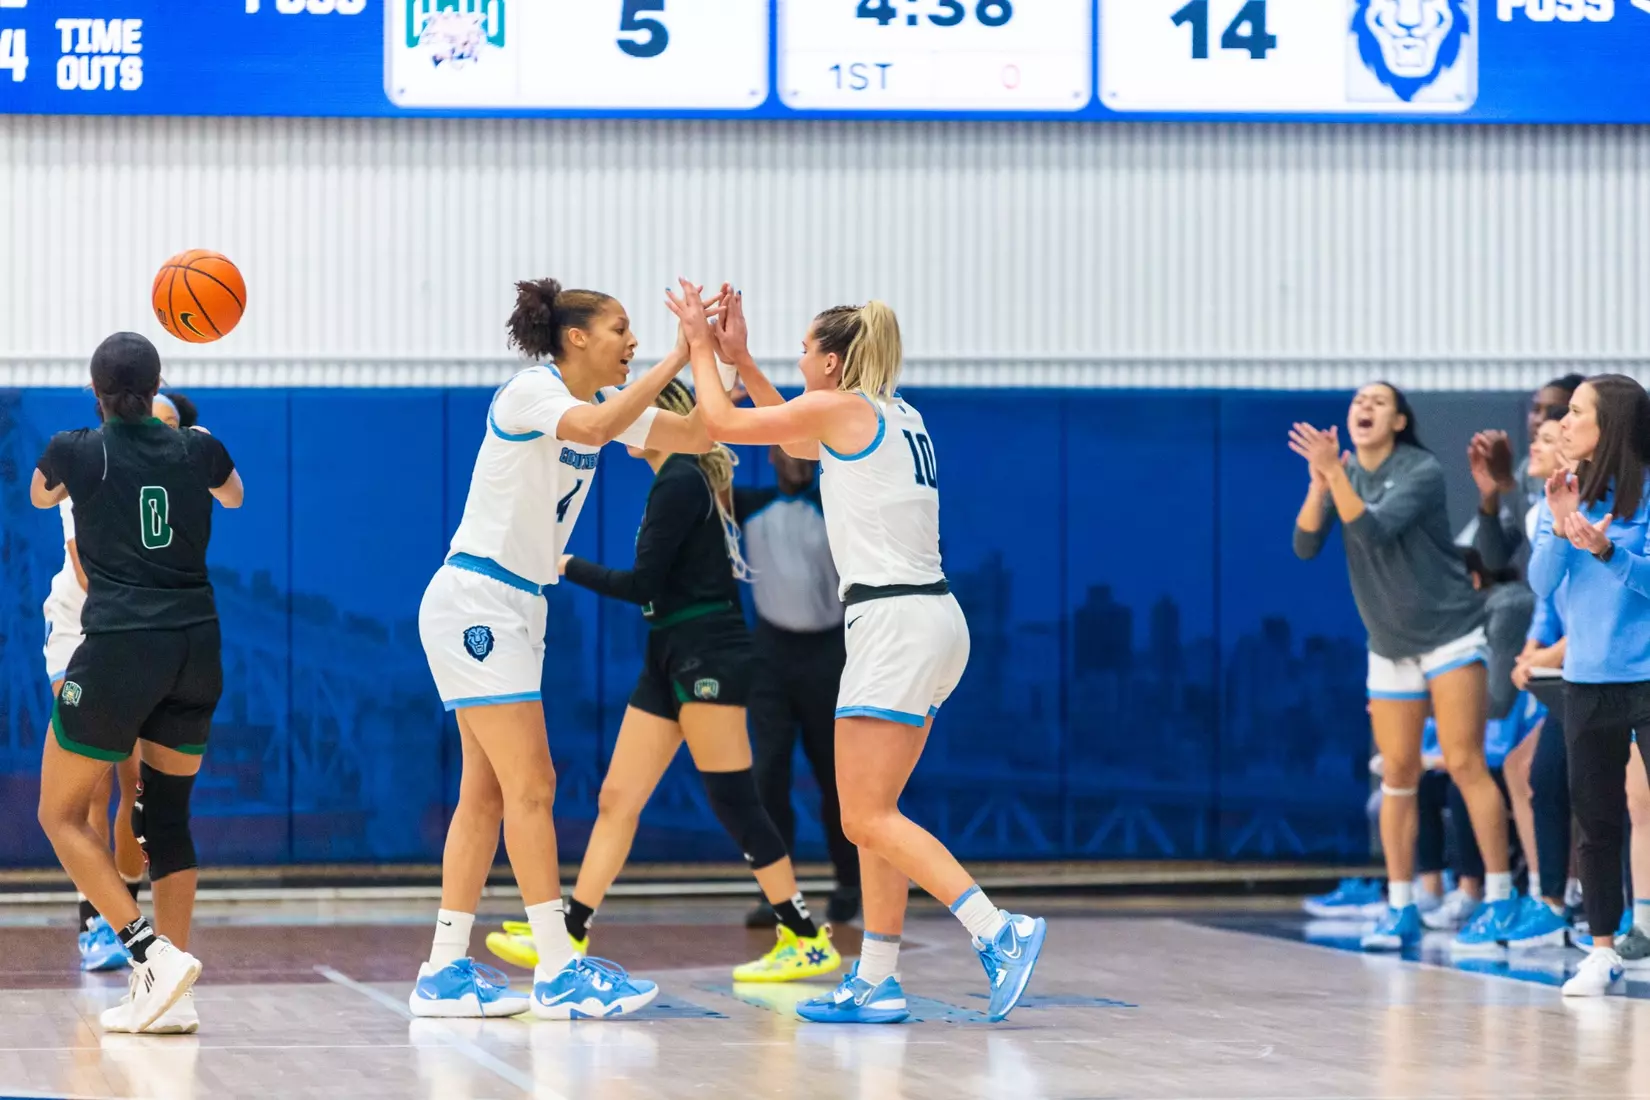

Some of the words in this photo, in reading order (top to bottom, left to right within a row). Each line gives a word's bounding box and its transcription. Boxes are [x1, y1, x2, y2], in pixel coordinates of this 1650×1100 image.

[0, 28, 29, 82] 4
[55, 18, 143, 53] TIME
[616, 0, 669, 58] 5
[1170, 0, 1277, 59] 14
[56, 55, 143, 91] OUTS
[829, 63, 893, 90] 1ST
[902, 429, 937, 489] 10
[140, 486, 173, 549] 0
[556, 479, 583, 523] 4
